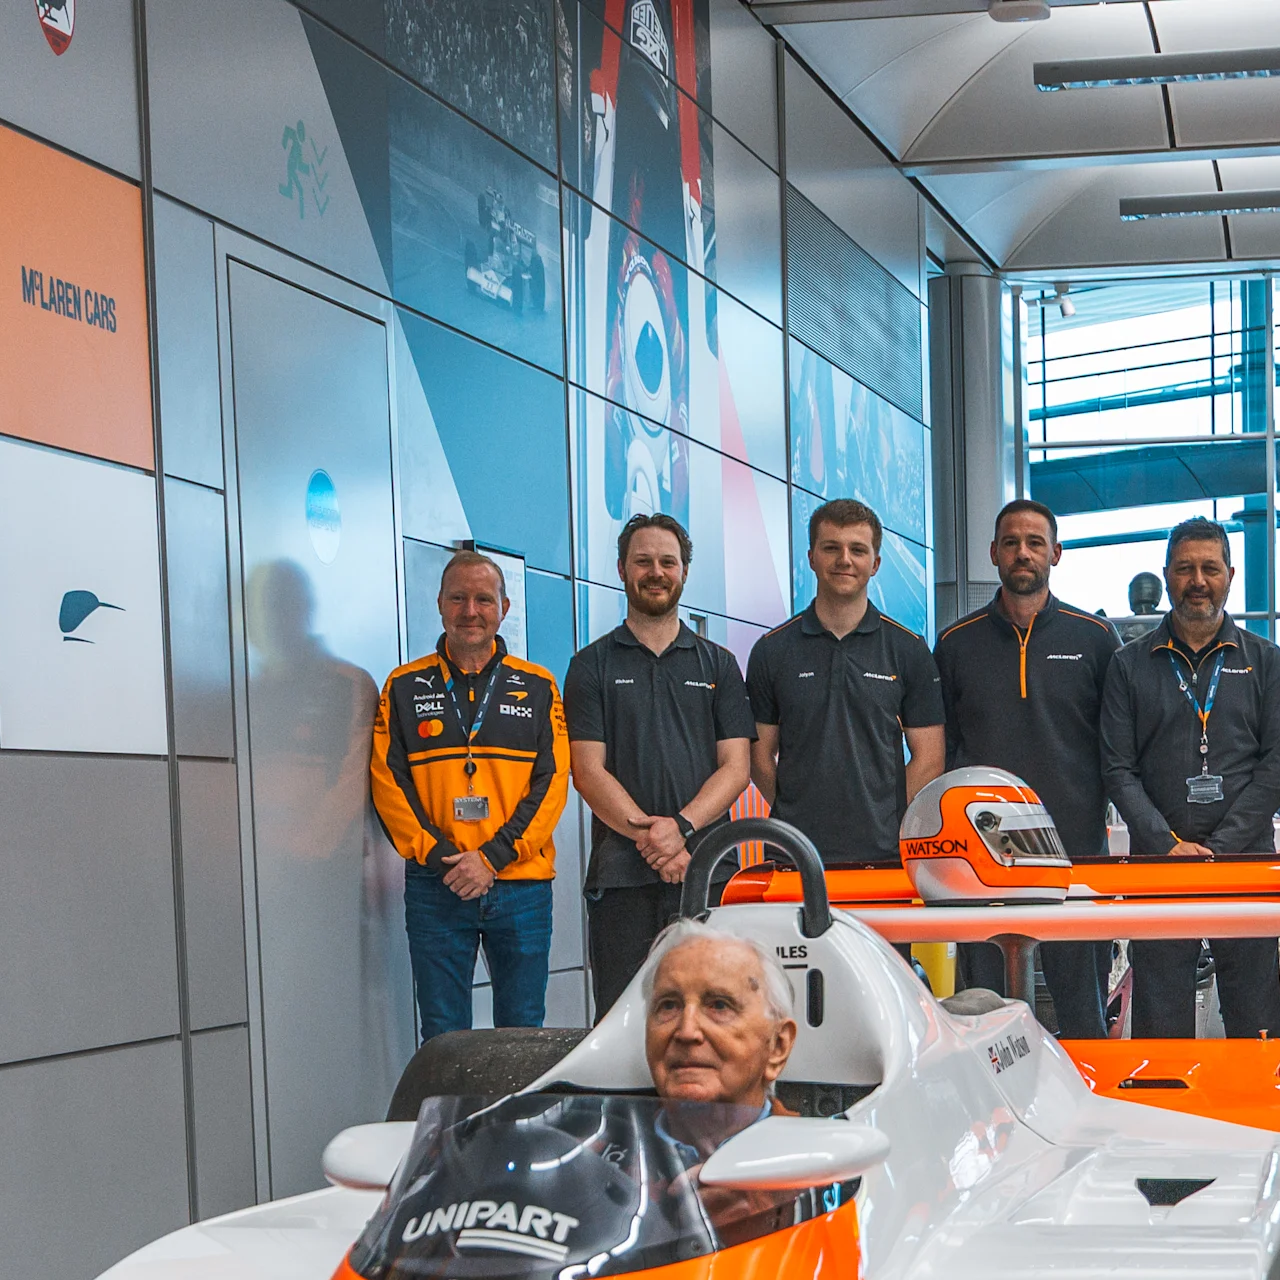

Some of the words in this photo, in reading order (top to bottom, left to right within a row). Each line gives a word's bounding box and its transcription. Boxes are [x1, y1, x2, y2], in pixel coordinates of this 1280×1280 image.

[84, 289, 117, 333] CARS
[863, 672, 894, 681] McLaren
[413, 693, 435, 701] Android
[415, 702, 444, 713] DELL
[499, 704, 533, 718] OKX
[906, 839, 968, 855] WATSON
[995, 1043, 1014, 1070] John
[1006, 1035, 1031, 1059] Watson
[401, 1200, 580, 1243] UNIPART
